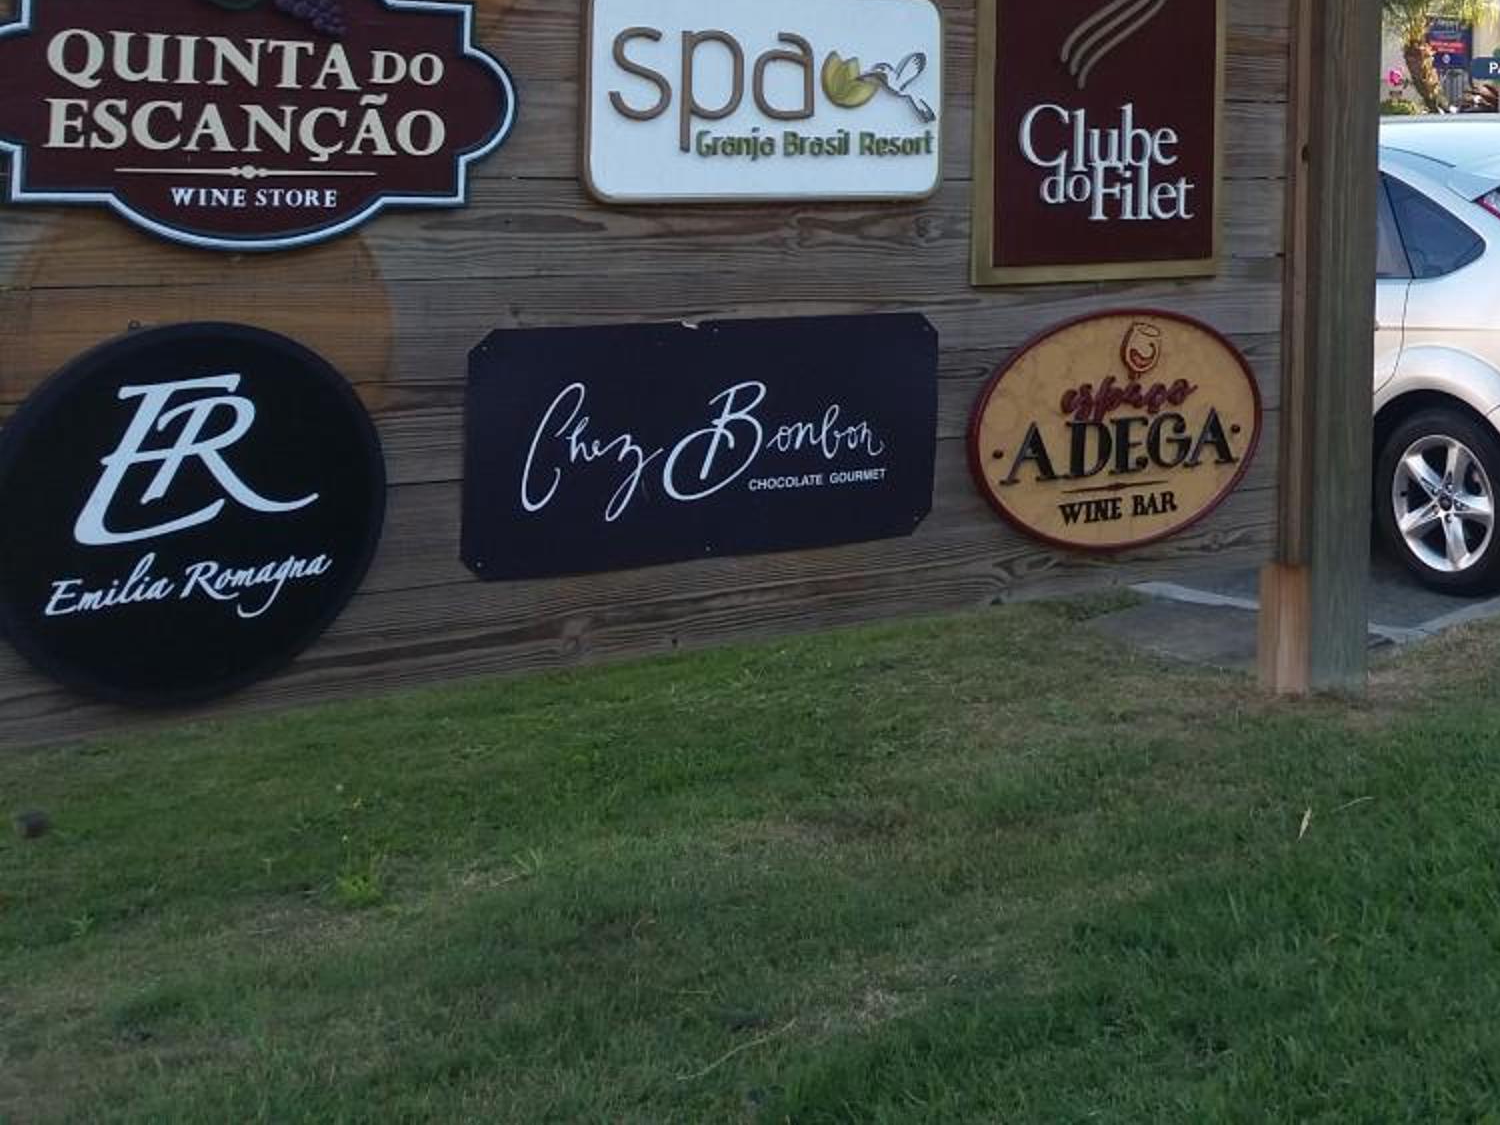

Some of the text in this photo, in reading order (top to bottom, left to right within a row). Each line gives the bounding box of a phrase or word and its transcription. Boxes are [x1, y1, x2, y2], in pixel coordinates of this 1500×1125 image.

[46, 28, 445, 91] QUINTA DO
[43, 94, 447, 162] ESCANÇÃO
[695, 127, 936, 161] Granja Brasil Resort
[1018, 102, 1180, 173] Clube
[171, 187, 339, 209] WINE STORE
[1040, 151, 1196, 222] do Filet
[521, 381, 884, 522] Chez Bonbon
[1000, 406, 1238, 487] ADEGA
[748, 468, 887, 492] CHOCOLATE GOURMET
[1058, 490, 1177, 525] WINE BAR
[44, 552, 333, 618] Emilia Romagna
